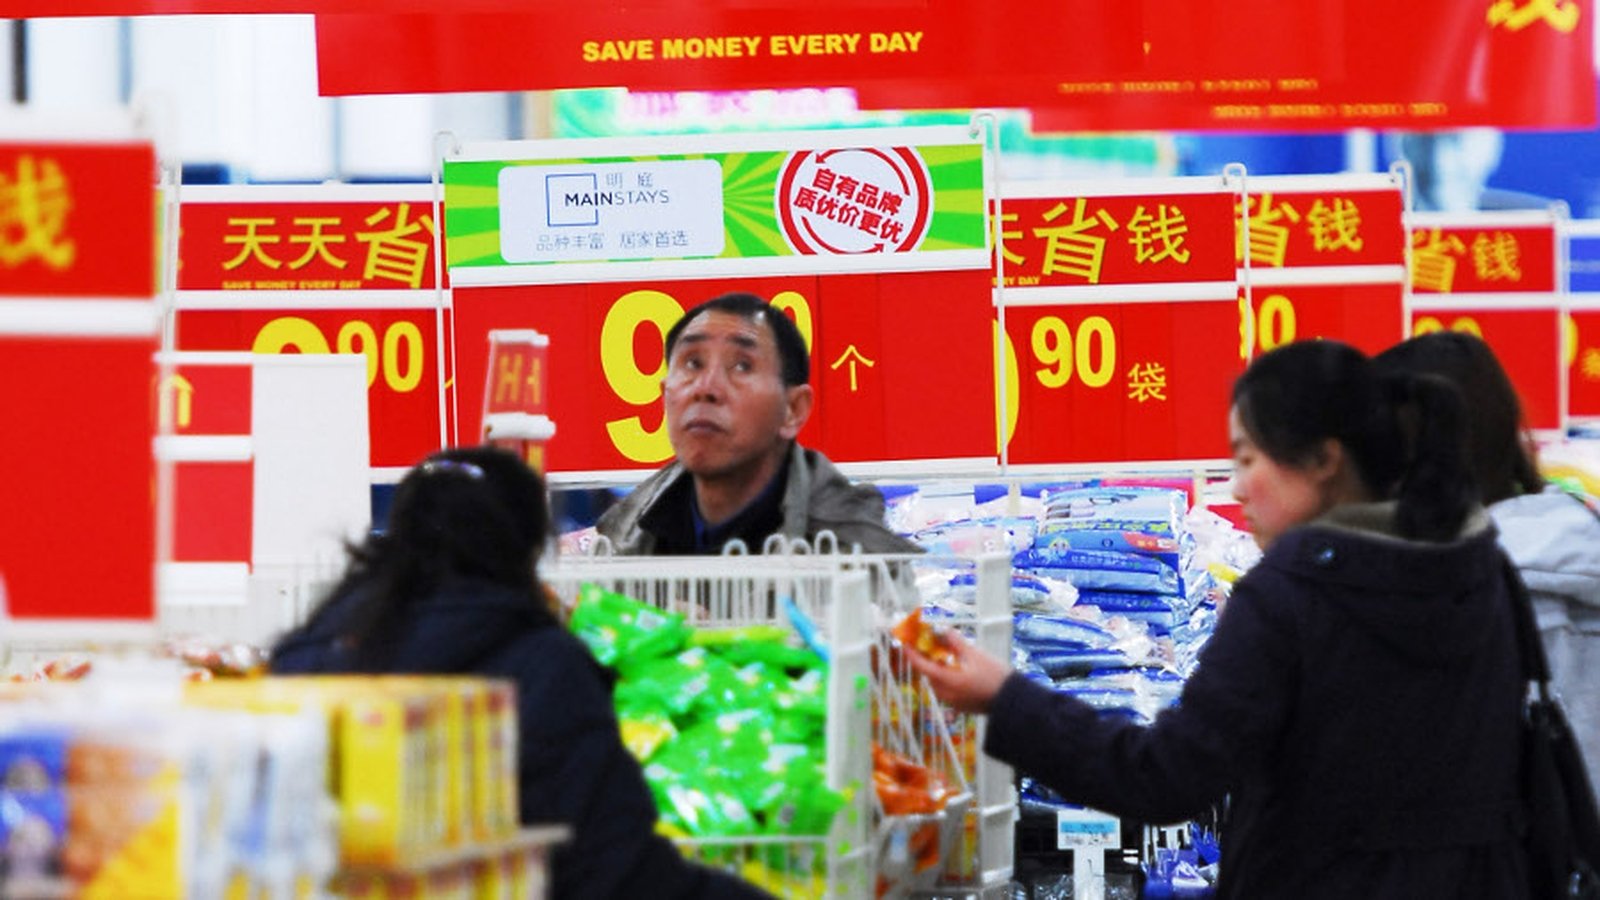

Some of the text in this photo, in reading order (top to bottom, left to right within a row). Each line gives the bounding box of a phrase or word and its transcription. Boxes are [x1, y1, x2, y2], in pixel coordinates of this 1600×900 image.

[582, 31, 923, 62] SAVE MONEY EVERY DAY
[564, 189, 670, 207] MAINSTAYS
[793, 186, 904, 244] 质优价更优
[812, 168, 903, 216] 自有品牌
[221, 202, 435, 289] 天天省
[1235, 193, 1364, 268] 省钱
[1018, 276, 1040, 286] DAY
[831, 344, 875, 392] 个
[1031, 315, 1116, 389] 90
[1127, 362, 1167, 403] 袋
